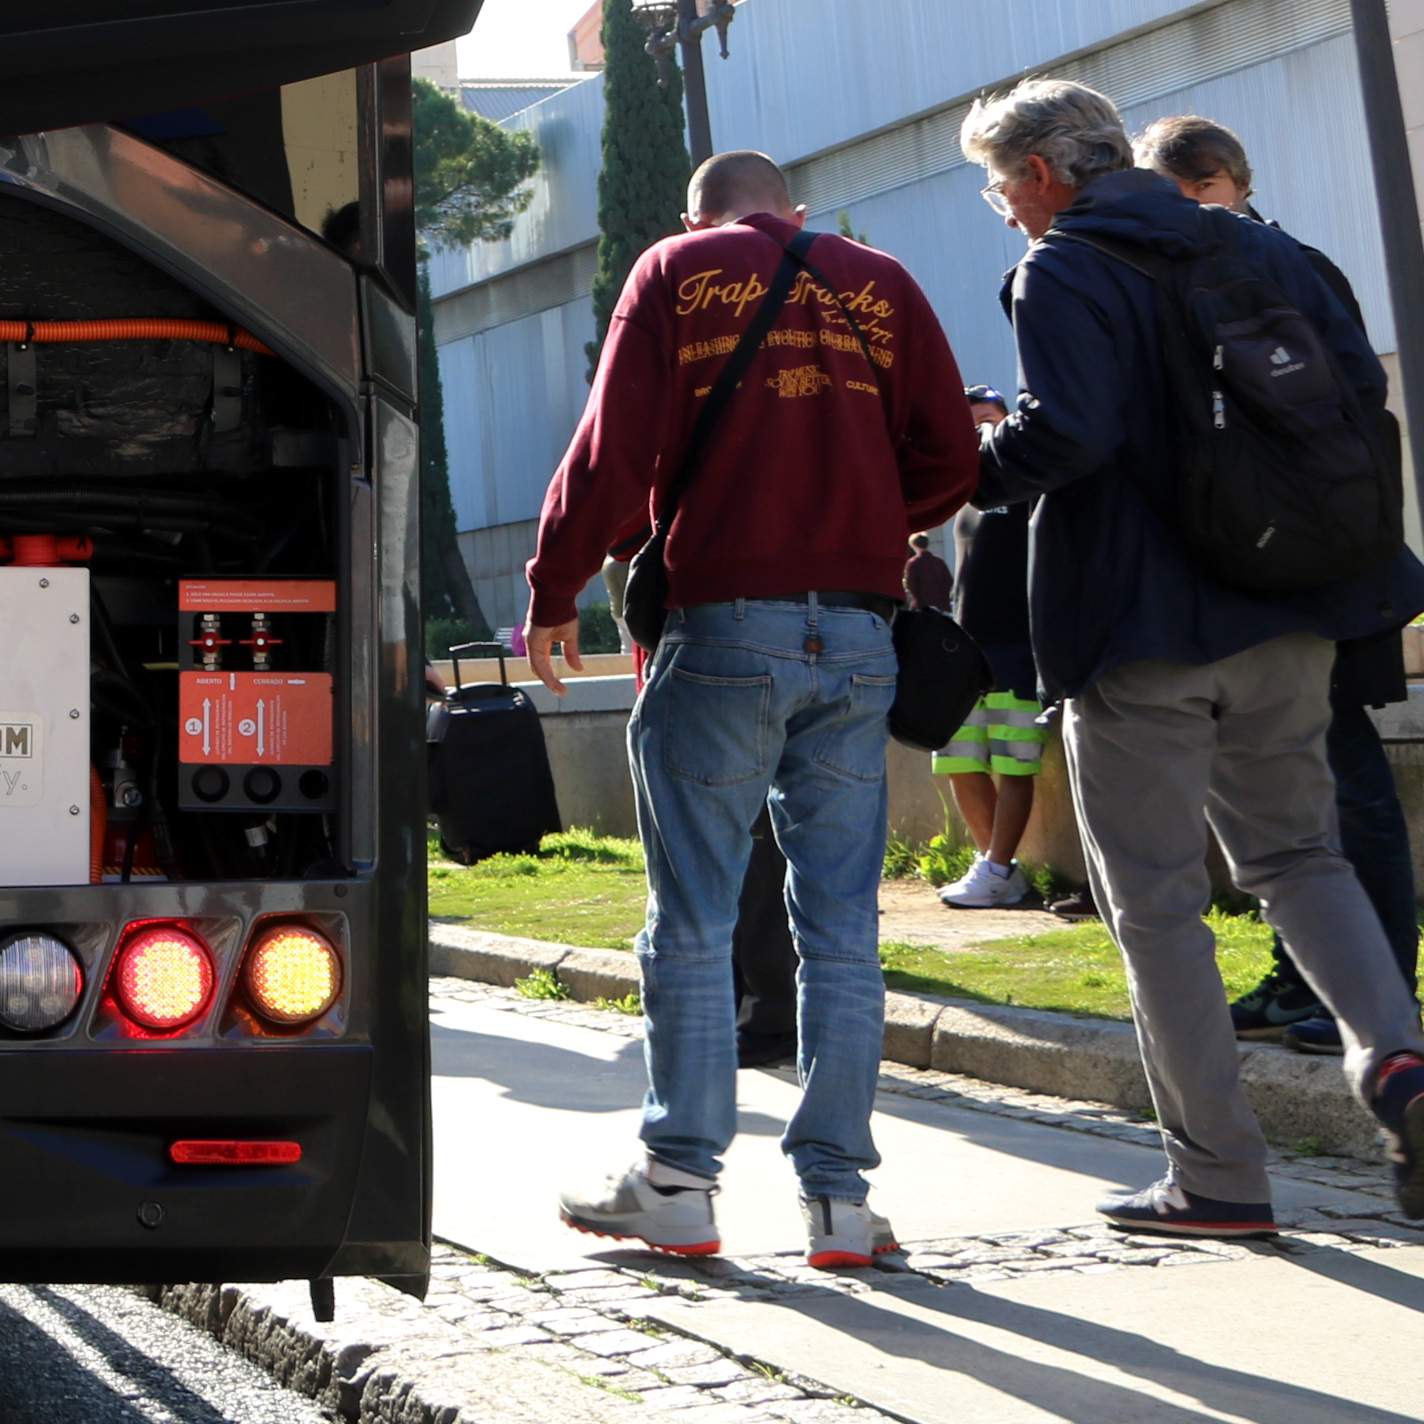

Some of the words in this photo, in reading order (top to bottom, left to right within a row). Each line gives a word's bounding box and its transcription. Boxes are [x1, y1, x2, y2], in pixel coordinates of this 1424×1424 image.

[676, 269, 768, 316] Trap
[189, 721, 197, 732] 1
[243, 722, 251, 732] 2
